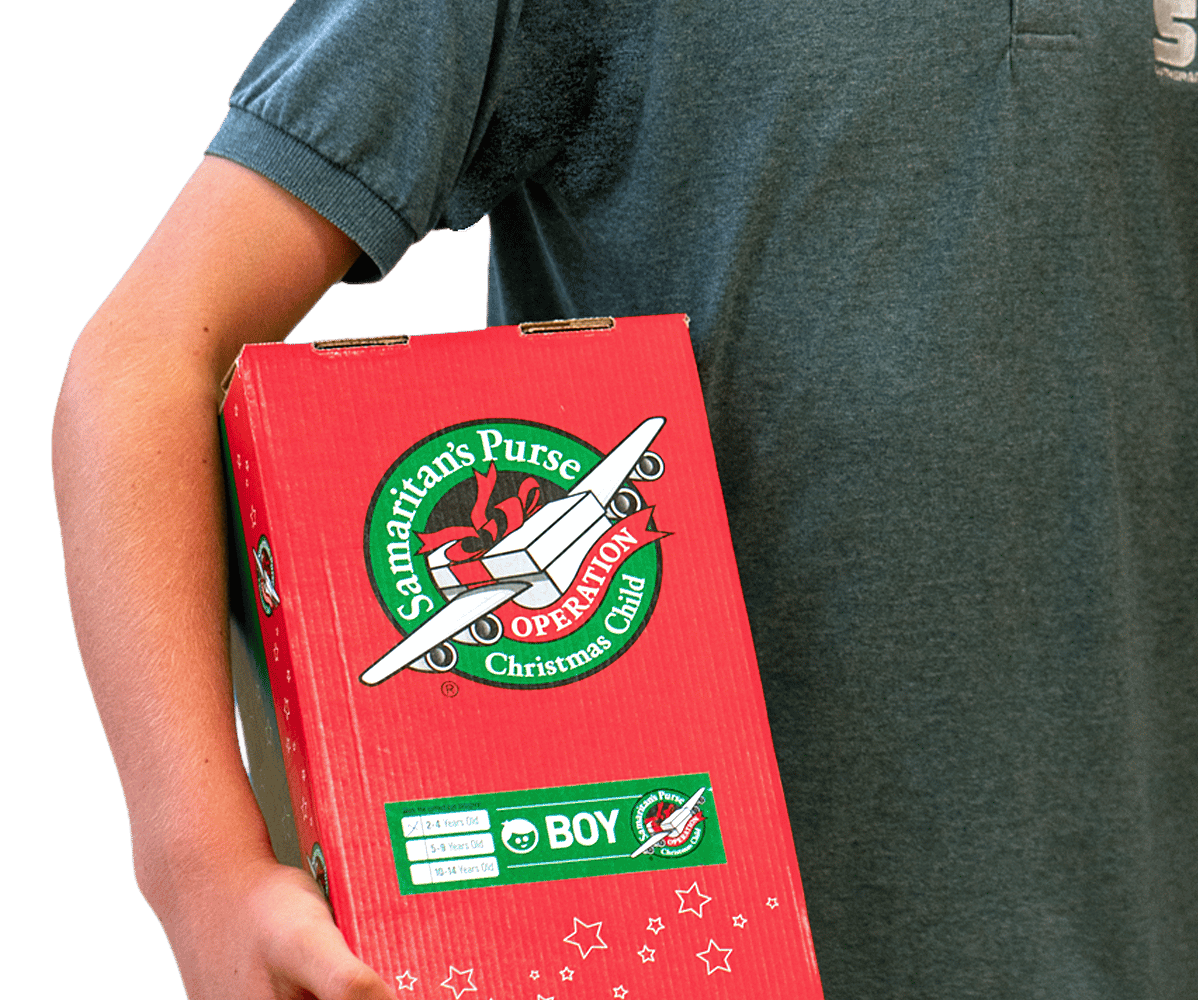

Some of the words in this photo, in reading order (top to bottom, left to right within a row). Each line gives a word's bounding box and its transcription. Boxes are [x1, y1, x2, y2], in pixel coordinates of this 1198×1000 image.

[386, 441, 476, 622] Samaritan's
[476, 428, 582, 482] Purse
[511, 526, 638, 638] OPERATION
[485, 634, 612, 678] Christmas
[604, 573, 646, 635] Child
[443, 818, 464, 828] Years
[545, 808, 620, 850] BOY
[448, 841, 469, 851] Years
[458, 864, 480, 874] Years
